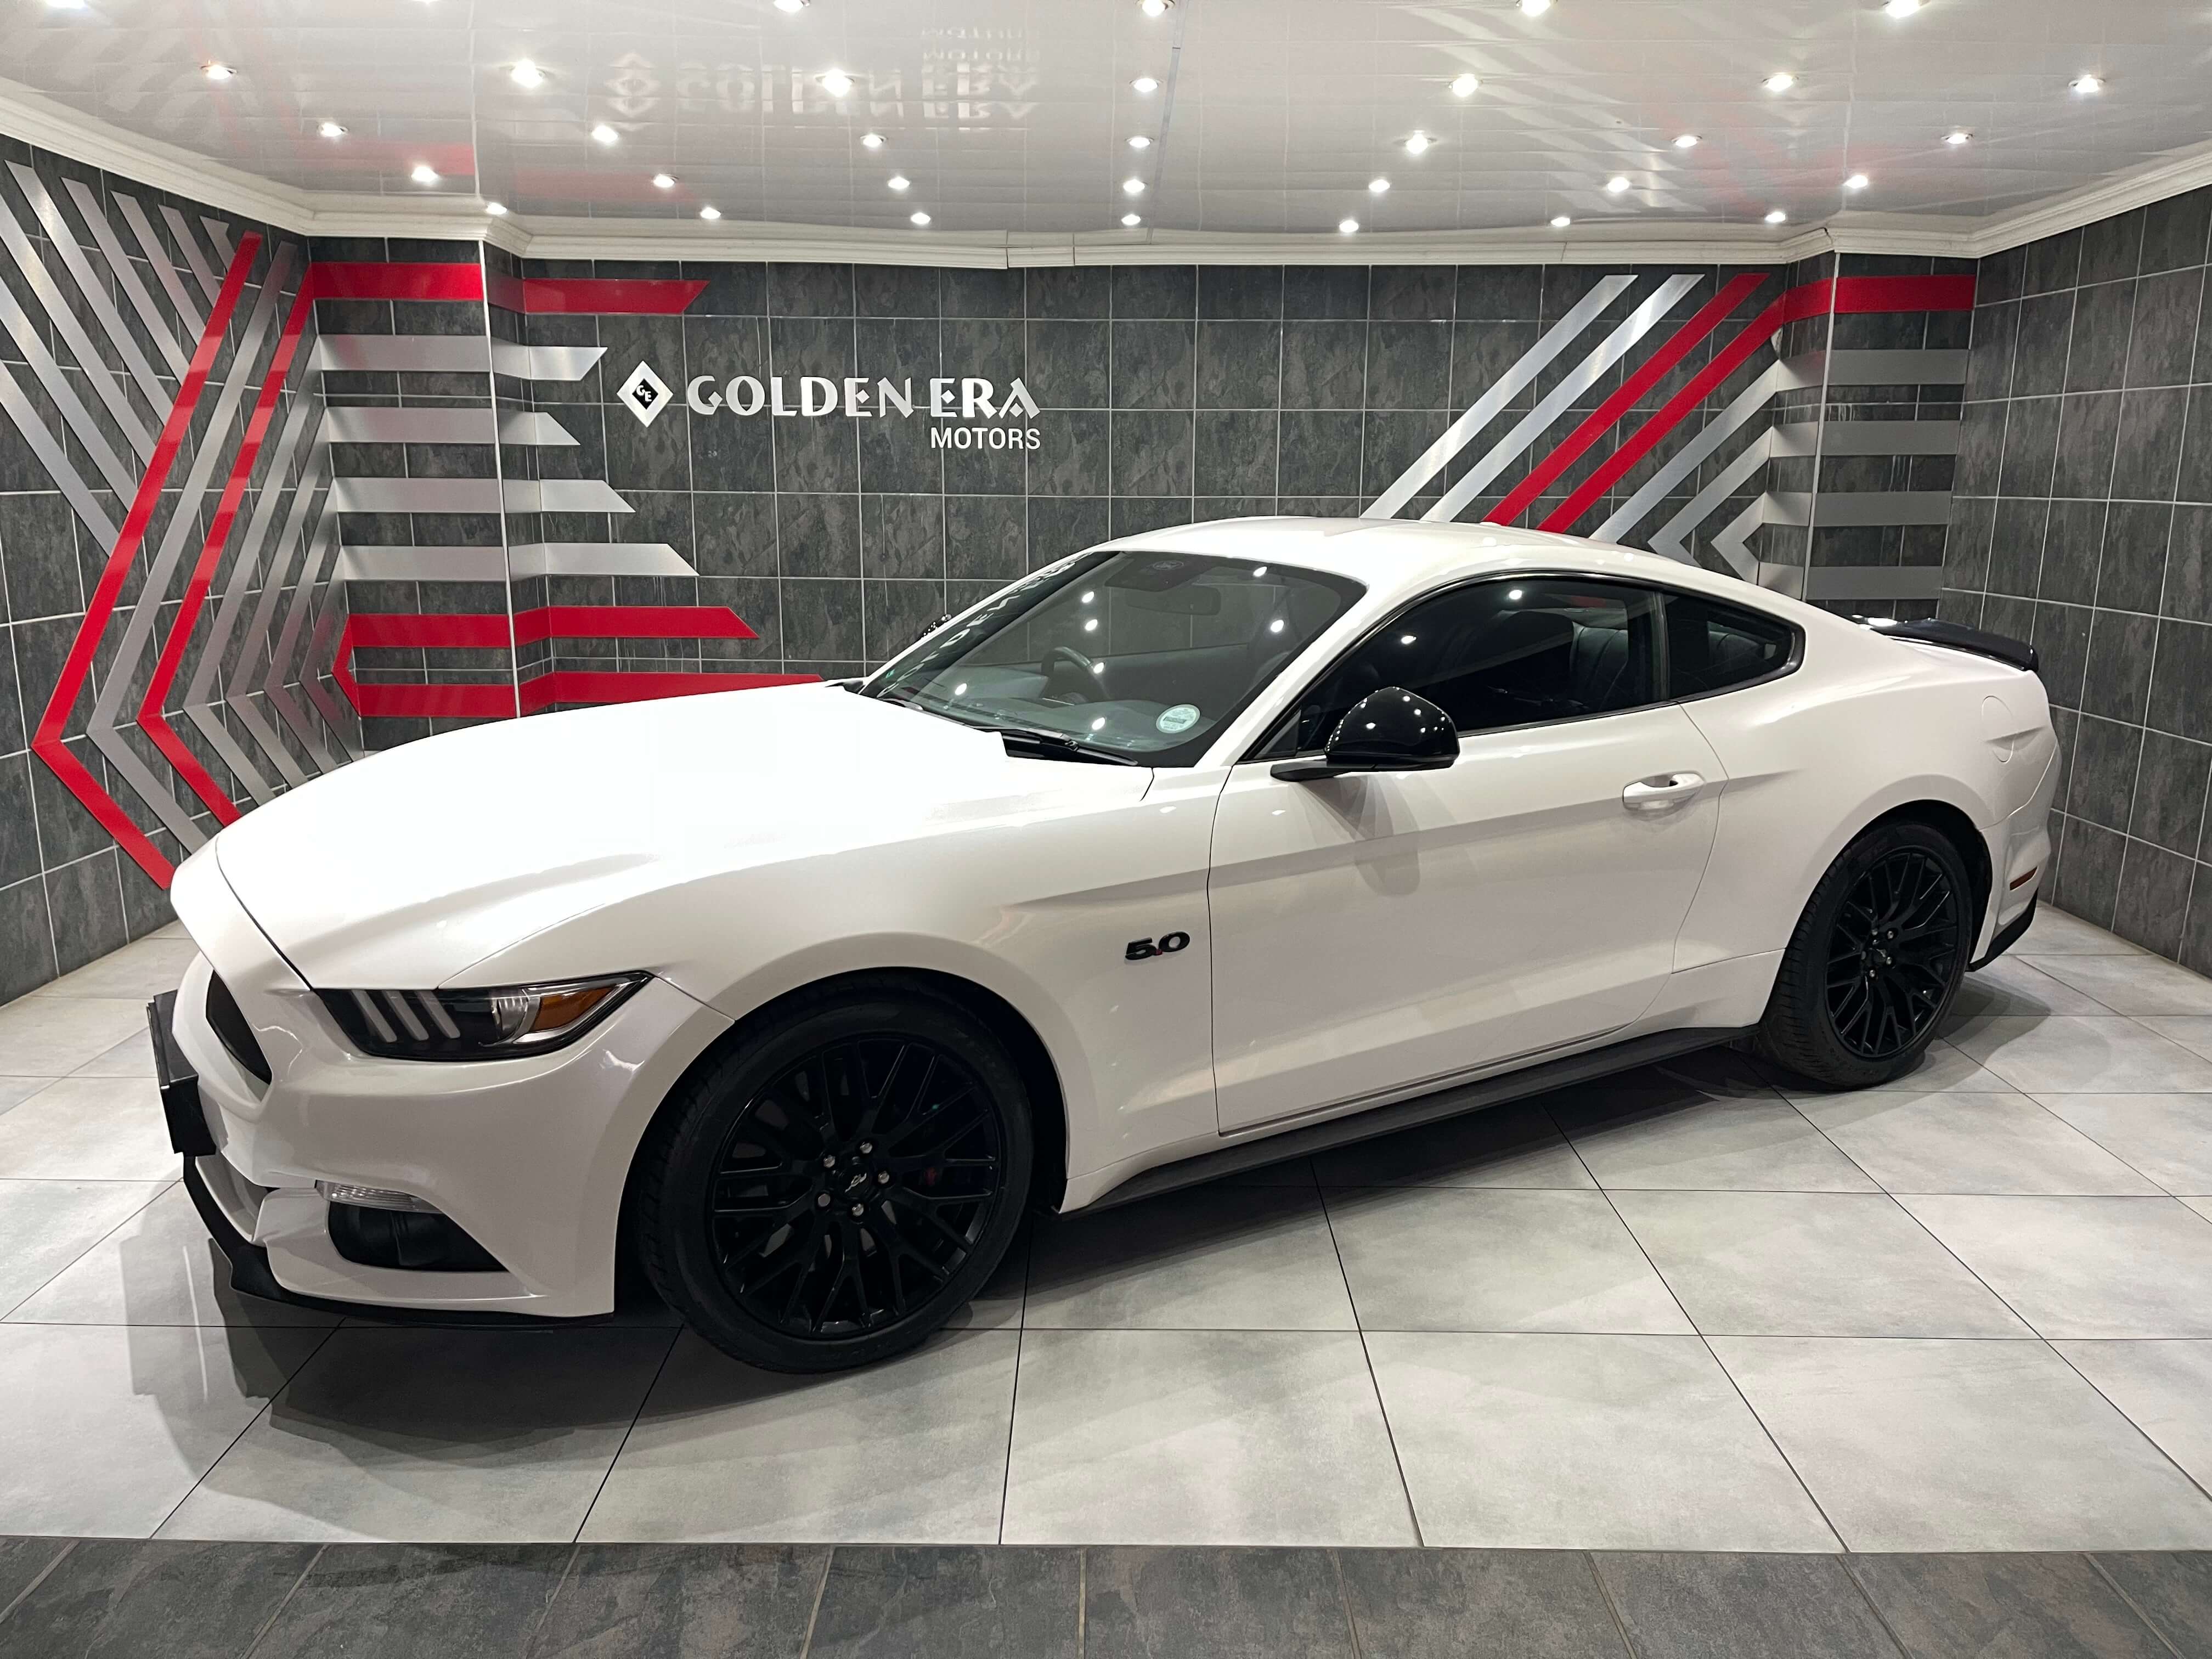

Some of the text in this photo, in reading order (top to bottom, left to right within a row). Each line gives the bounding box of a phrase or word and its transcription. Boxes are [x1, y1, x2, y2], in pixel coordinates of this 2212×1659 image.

[636, 385, 653, 402] GE
[687, 375, 1041, 419] GOLDEN ERA
[930, 426, 1041, 450] MOTORS
[1125, 931, 1190, 961] 5.0
